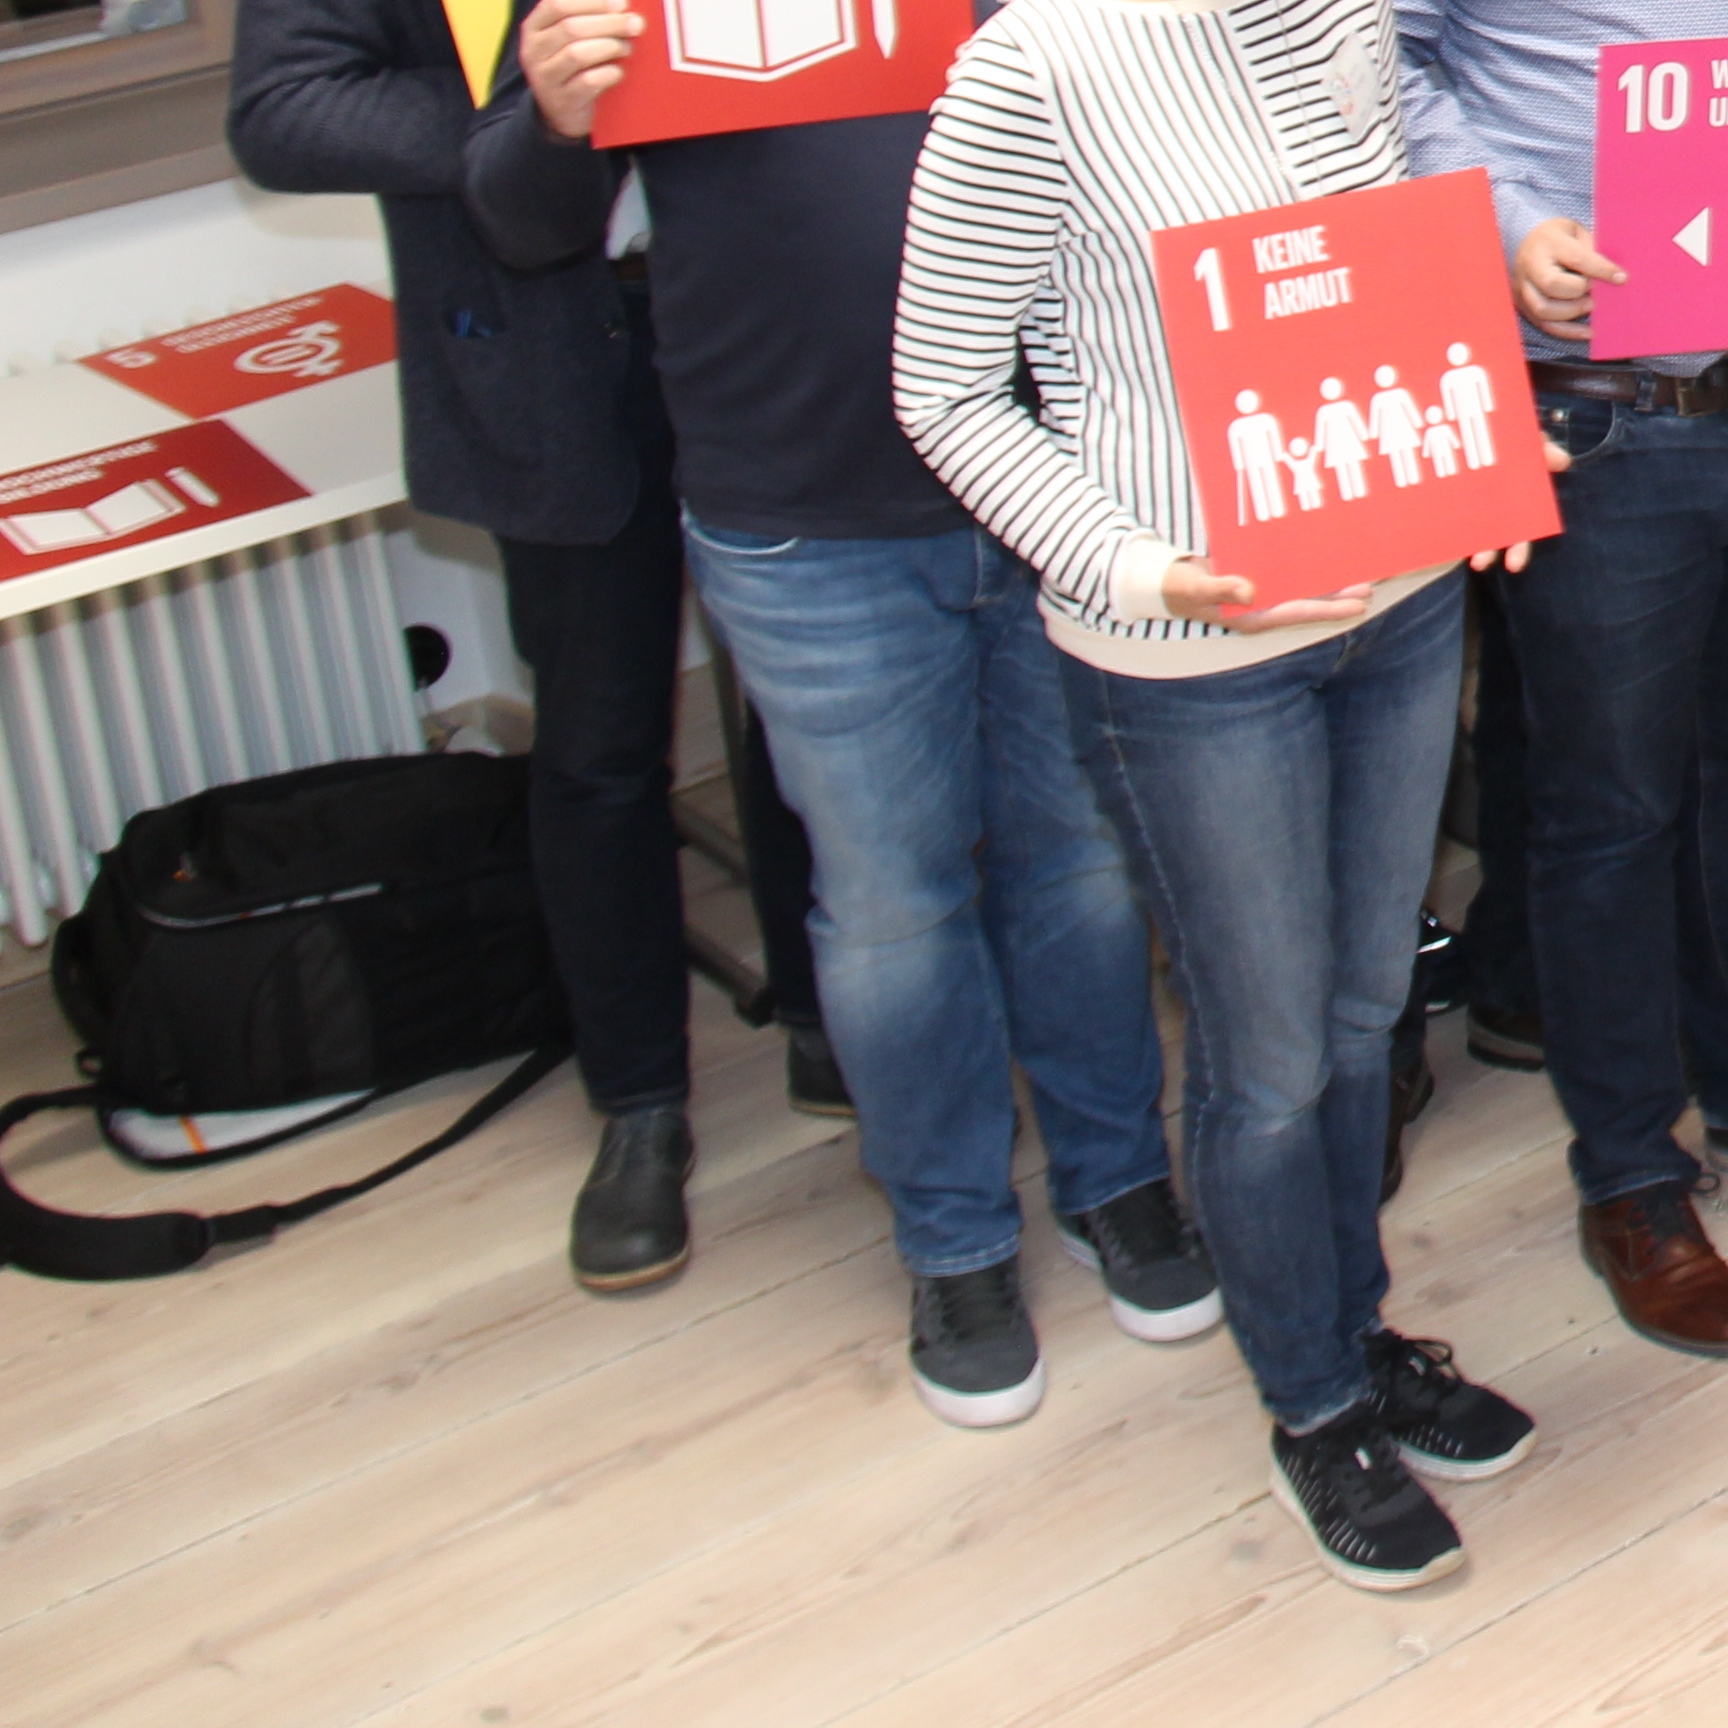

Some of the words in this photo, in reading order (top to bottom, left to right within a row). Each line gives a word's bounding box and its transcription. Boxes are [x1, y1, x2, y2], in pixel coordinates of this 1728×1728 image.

[1618, 62, 1689, 133] 10
[1252, 225, 1330, 273] KEINE
[1193, 247, 1232, 331] 1
[1265, 267, 1352, 319] ARMUT
